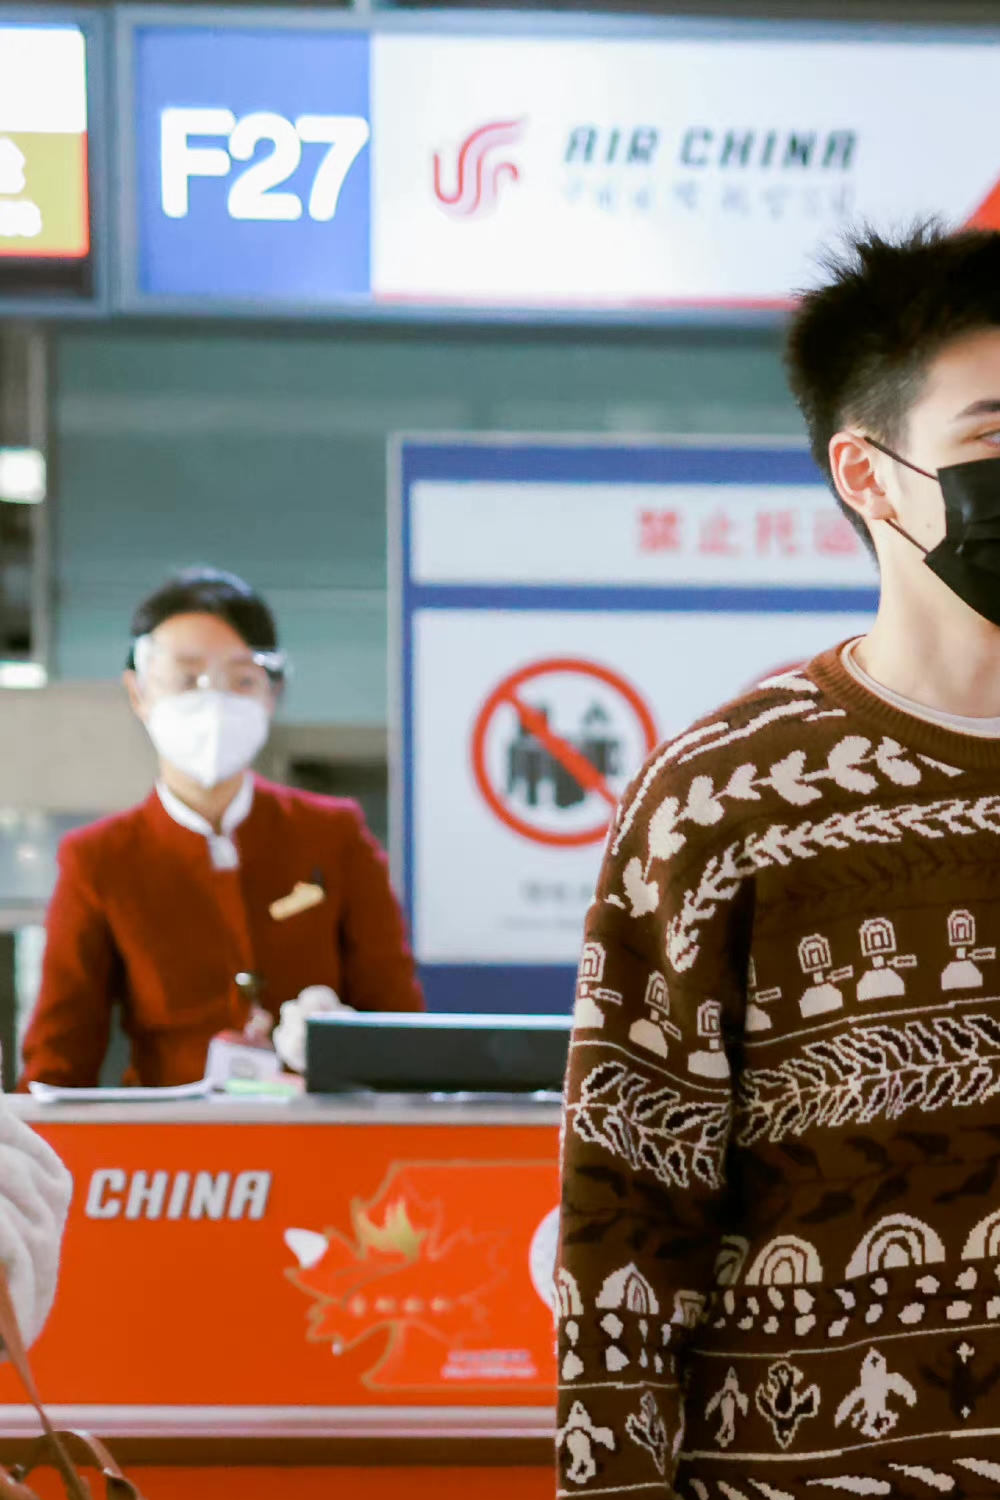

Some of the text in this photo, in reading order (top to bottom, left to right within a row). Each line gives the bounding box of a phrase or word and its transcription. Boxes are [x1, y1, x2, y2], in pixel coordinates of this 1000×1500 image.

[160, 107, 370, 221] F27
[563, 124, 858, 169] AIR CHINA
[85, 1168, 271, 1221] CHINA
